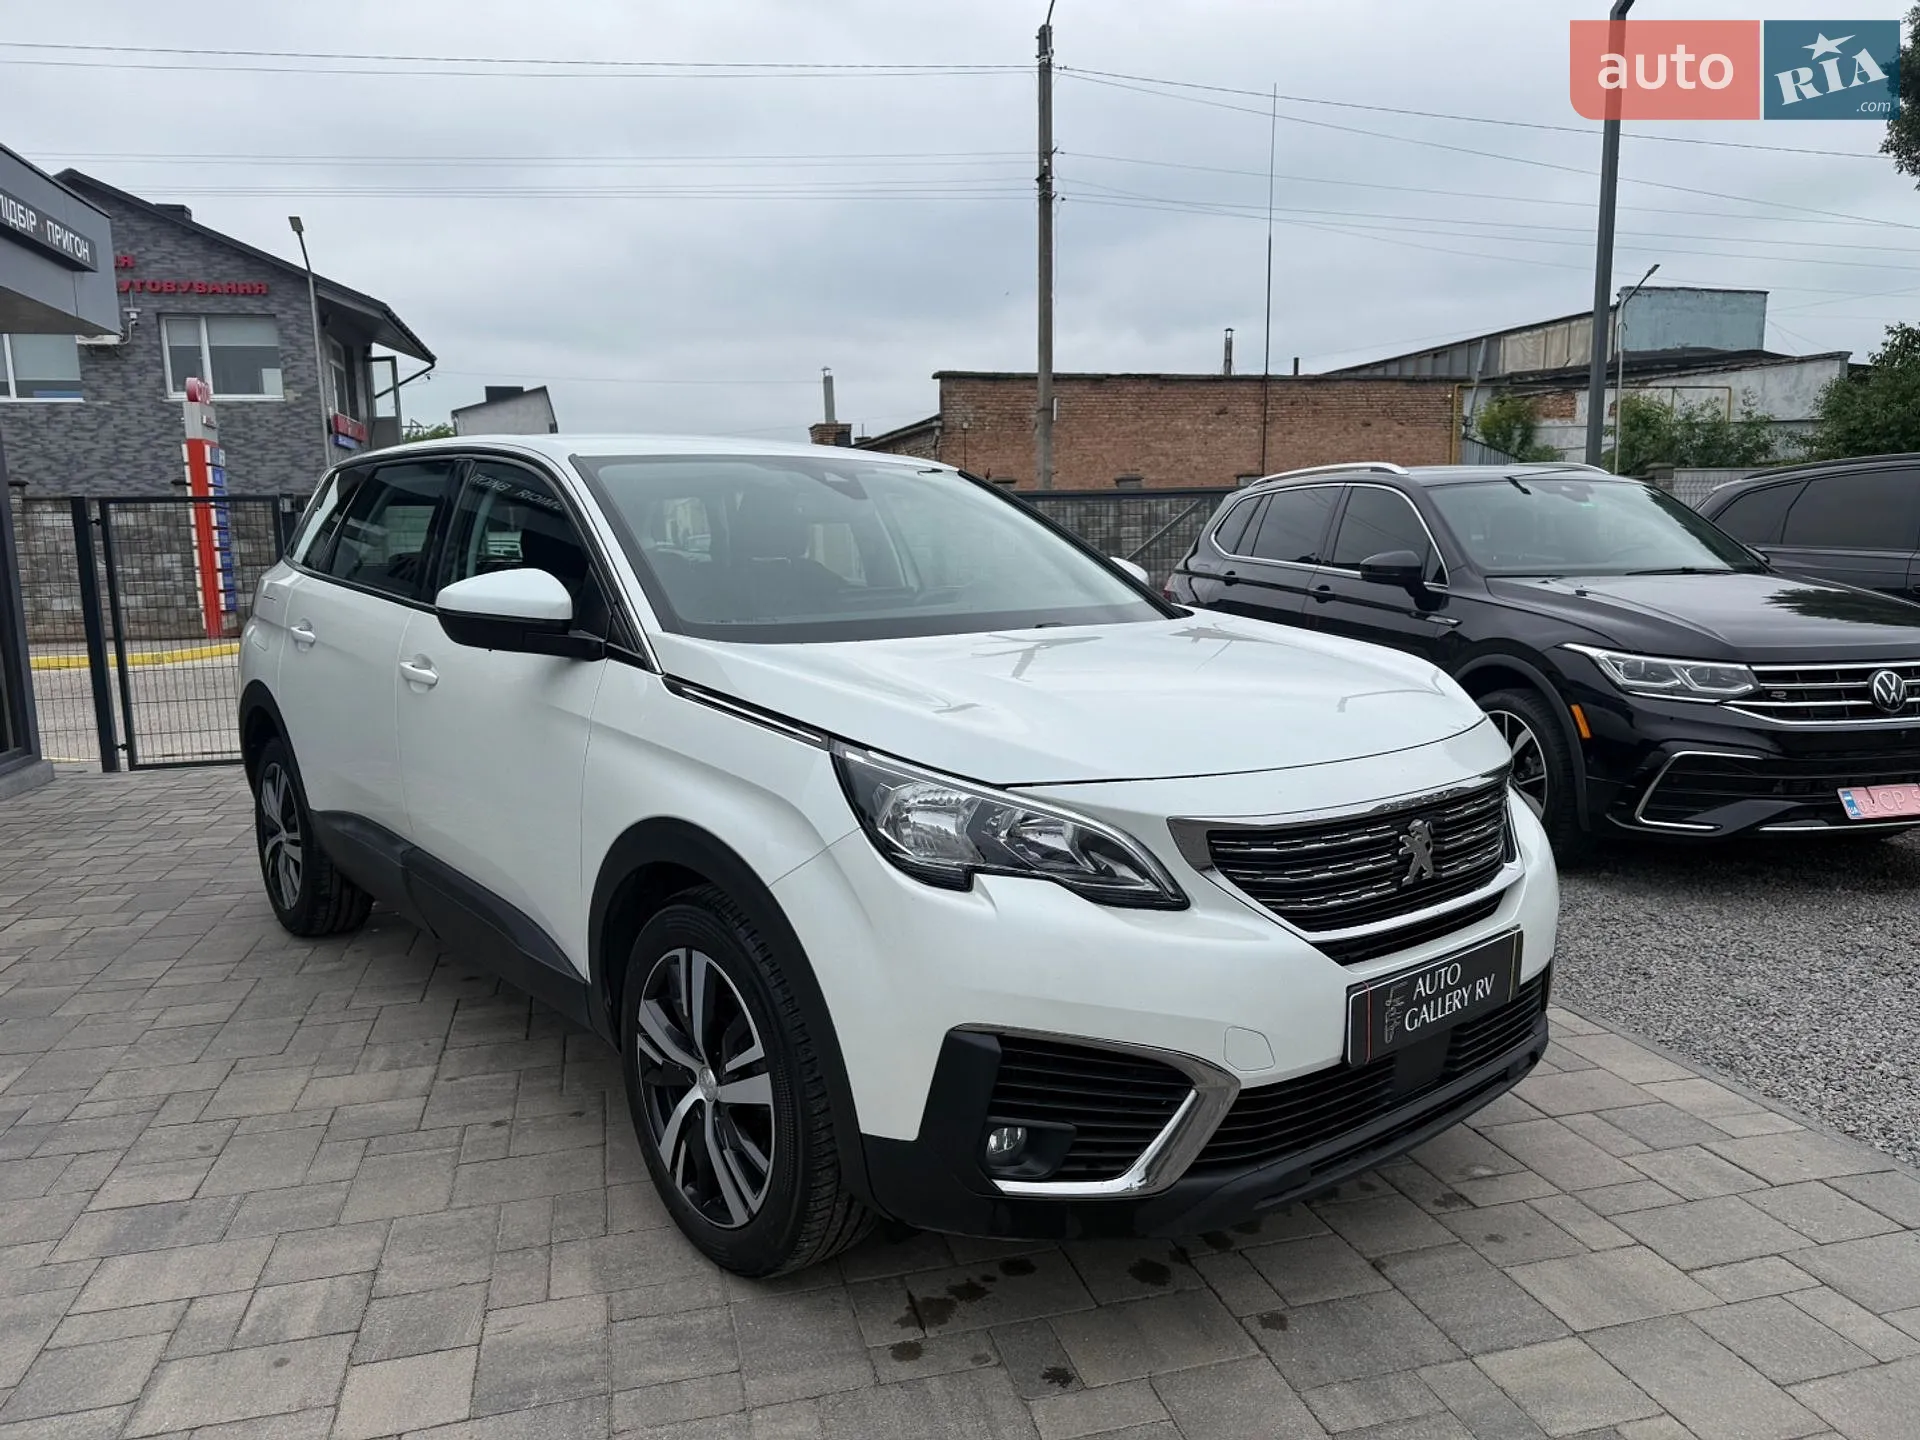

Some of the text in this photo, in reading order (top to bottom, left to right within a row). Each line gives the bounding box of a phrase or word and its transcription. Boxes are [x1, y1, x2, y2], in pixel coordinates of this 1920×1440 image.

[46, 219, 90, 263] ПРИГОН
[1404, 973, 1496, 1032] GALLERY RV
[1413, 962, 1462, 1001] AUTO
